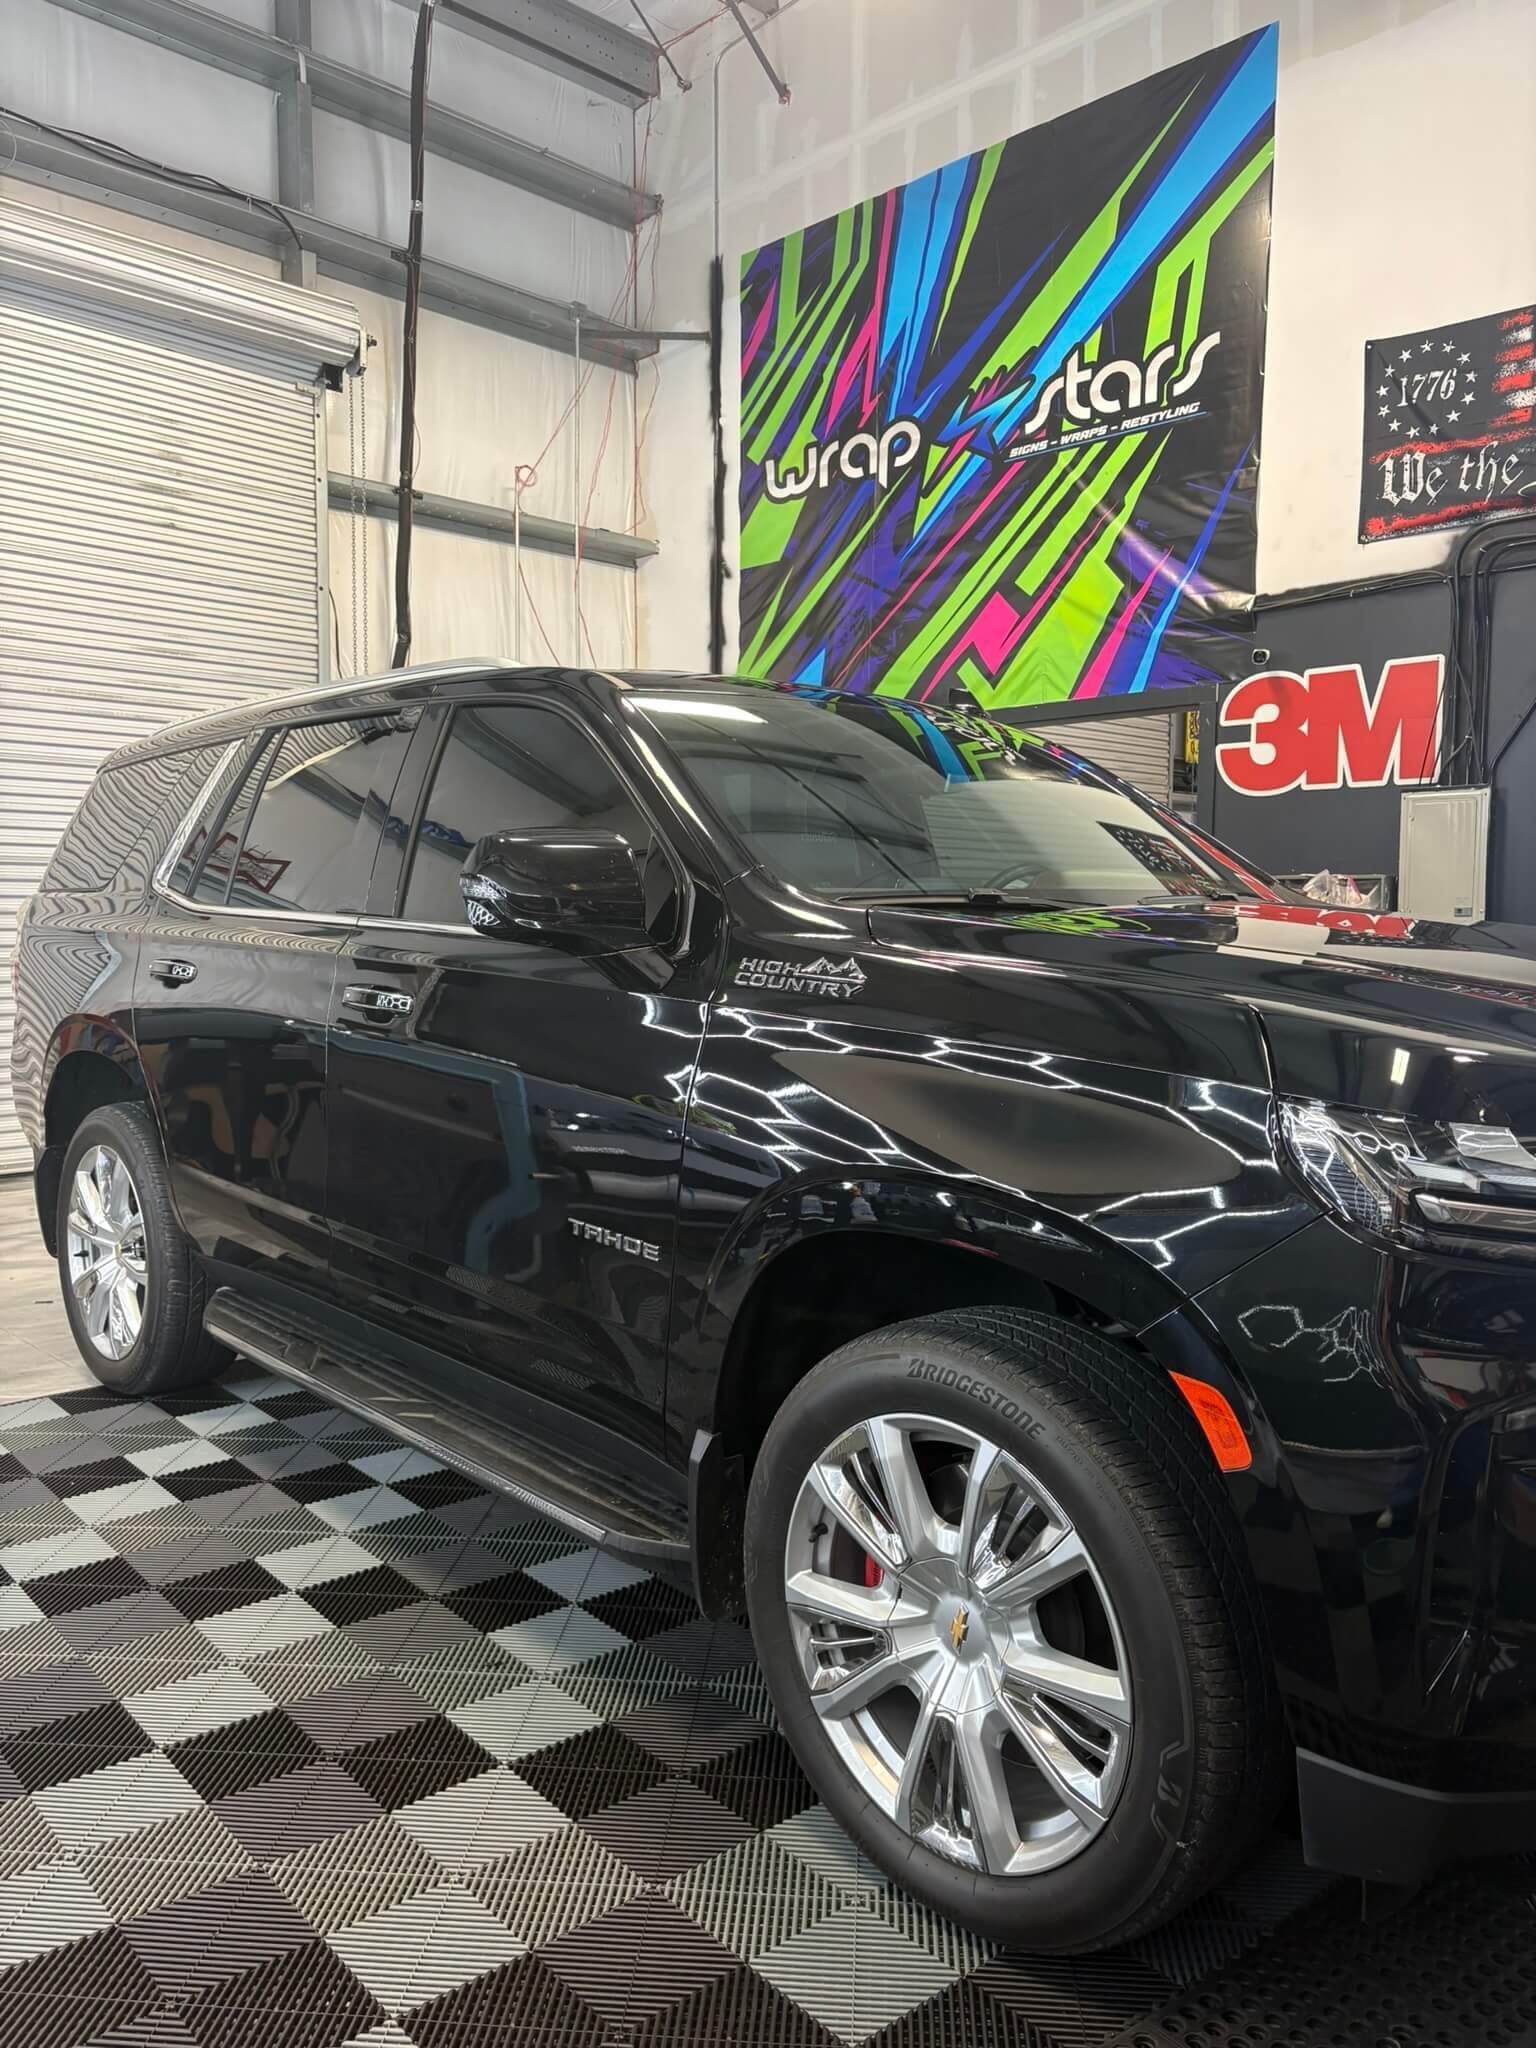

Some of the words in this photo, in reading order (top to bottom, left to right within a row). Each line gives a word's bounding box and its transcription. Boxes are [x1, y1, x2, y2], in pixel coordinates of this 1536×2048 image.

[765, 420, 921, 499] wrap
[1024, 331, 1221, 434] stars
[1397, 367, 1457, 407] 1776
[1009, 440, 1048, 458] SIGNS
[1060, 425, 1108, 445] WRAPS
[1120, 401, 1201, 431] RESTYLING
[1378, 450, 1449, 507] We
[1458, 440, 1524, 504] the
[1215, 654, 1446, 797] 3M
[734, 972, 865, 998] COUNTRY
[739, 957, 802, 977] HIGH
[567, 1217, 660, 1262] TAHOE
[907, 1358, 1046, 1441] BRIDGESTONE
